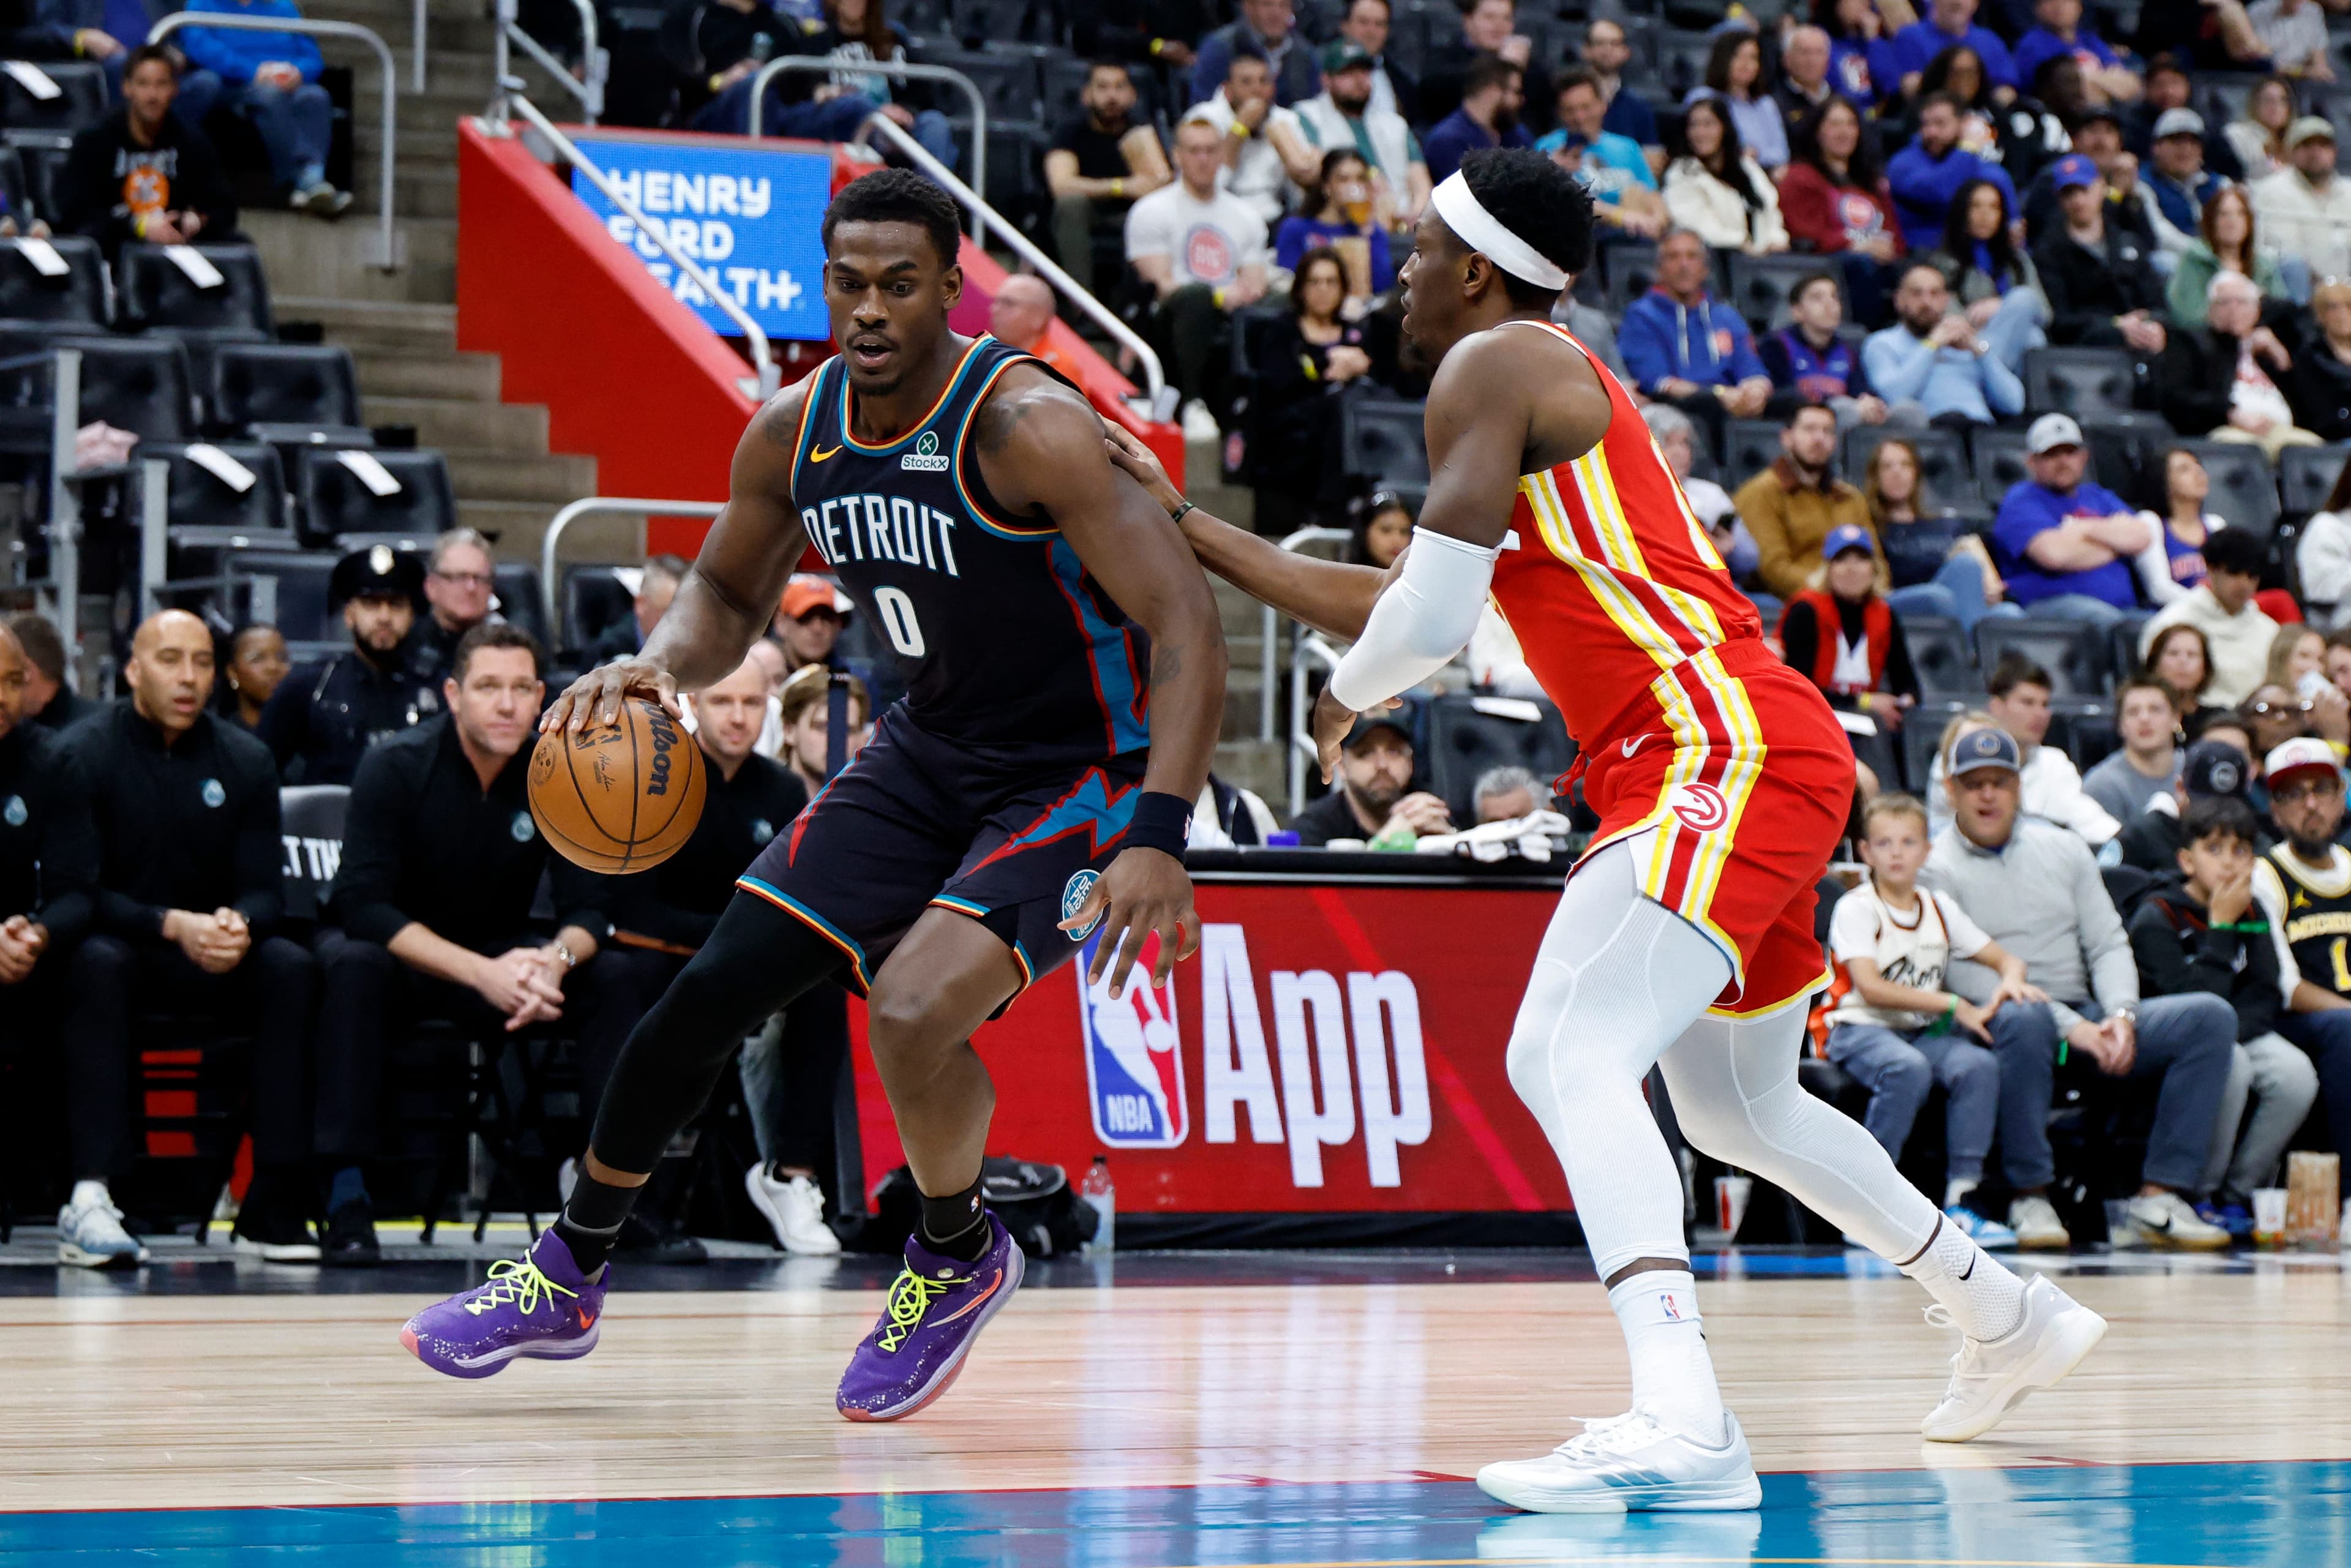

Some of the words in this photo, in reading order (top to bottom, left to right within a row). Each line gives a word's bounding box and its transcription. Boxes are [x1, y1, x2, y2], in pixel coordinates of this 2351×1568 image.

[903, 456, 948, 469] StockX
[801, 492, 962, 579] DETROIT
[873, 585, 926, 659] 0
[637, 700, 678, 796] Wilson
[1200, 923, 1433, 1188] App
[1106, 1093, 1153, 1133] NBA
